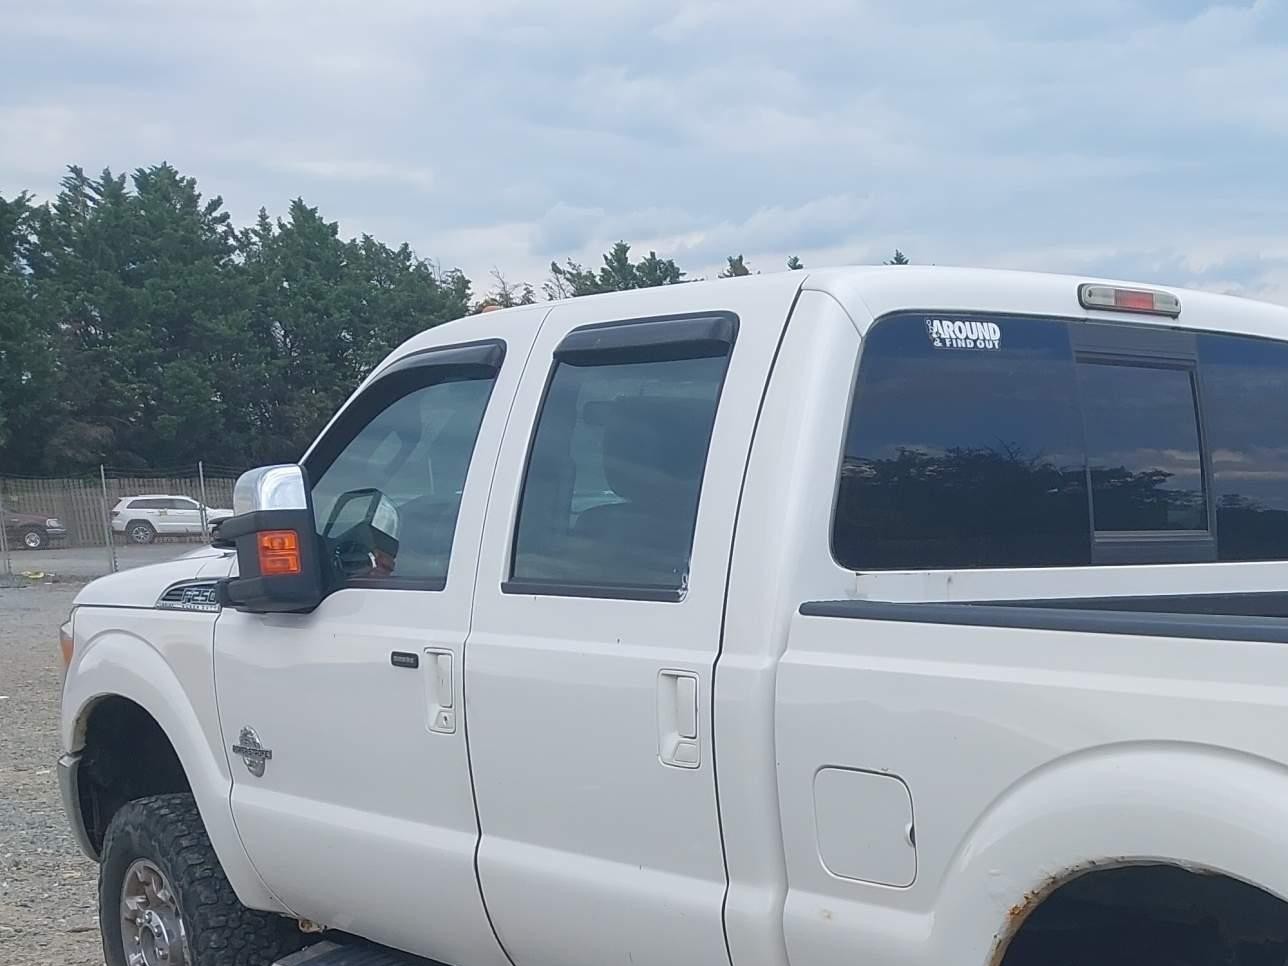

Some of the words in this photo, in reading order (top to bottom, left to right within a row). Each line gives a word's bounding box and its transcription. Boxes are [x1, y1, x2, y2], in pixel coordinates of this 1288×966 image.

[932, 320, 1000, 340] AROUND
[933, 338, 943, 347] &
[946, 339, 974, 348] FIND
[976, 339, 1000, 349] OUT
